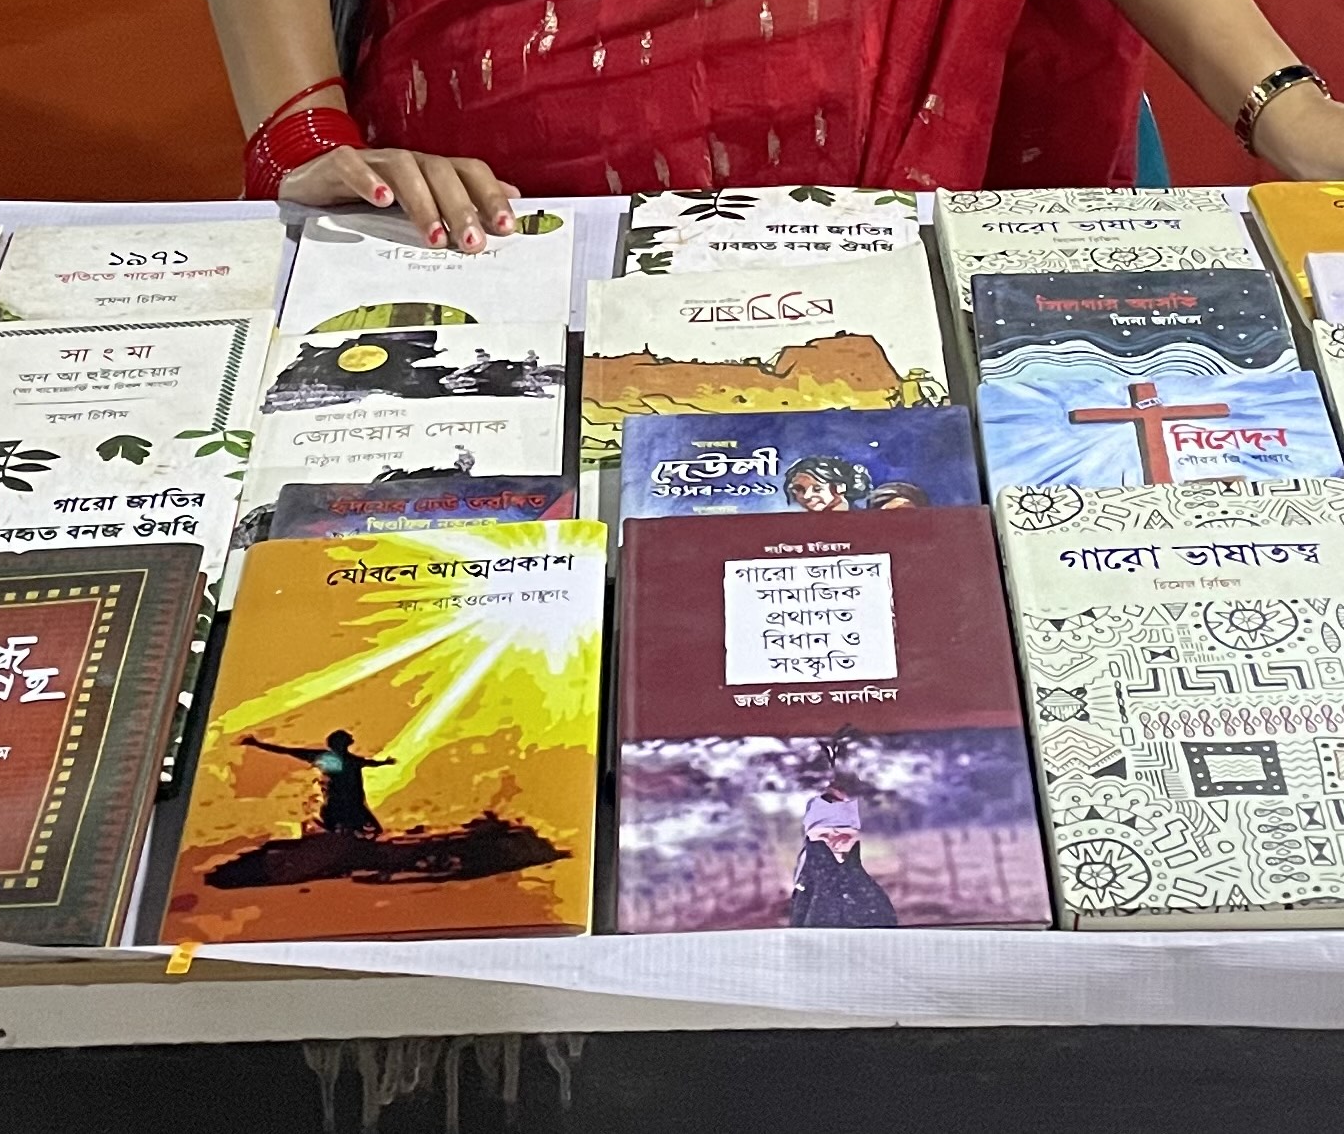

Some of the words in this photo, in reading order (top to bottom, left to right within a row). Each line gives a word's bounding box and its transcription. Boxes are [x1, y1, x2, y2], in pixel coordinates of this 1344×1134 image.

[766, 224, 818, 235] গারো
[826, 223, 893, 236] জাতির
[982, 221, 1060, 235] গারো
[784, 242, 831, 251] বনজ
[108, 250, 189, 266] ১৯৭১
[124, 271, 165, 282] গারো
[19, 373, 49, 383] অন
[56, 371, 82, 382] আ
[45, 413, 83, 423] সুমনা
[87, 410, 130, 421] চিসিম
[292, 424, 415, 446] জ্যোৎস্নার
[425, 420, 509, 437] দেমাক
[1169, 423, 1288, 453] নিবেদন
[347, 451, 403, 463] রাকসাম
[651, 446, 780, 485] দেউলী
[54, 493, 117, 515] গারো
[125, 489, 206, 511] জাতির
[65, 524, 123, 542] বনজ
[130, 516, 199, 539] ঔষধি
[1058, 542, 1162, 574] গারো
[326, 559, 419, 586] যৌবনে
[427, 553, 575, 579] আত্মপ্রকাশ
[735, 565, 797, 583] গারো
[805, 559, 882, 581] জাতির
[756, 582, 861, 604] সামাজিক
[765, 608, 853, 627] প্রথাগত
[763, 630, 830, 650] বিধান
[841, 632, 861, 646] ও
[768, 650, 858, 679] সংস্কৃতি
[733, 689, 773, 708] জর্জ
[777, 691, 824, 706] গনত
[829, 686, 899, 704] মানখিন
